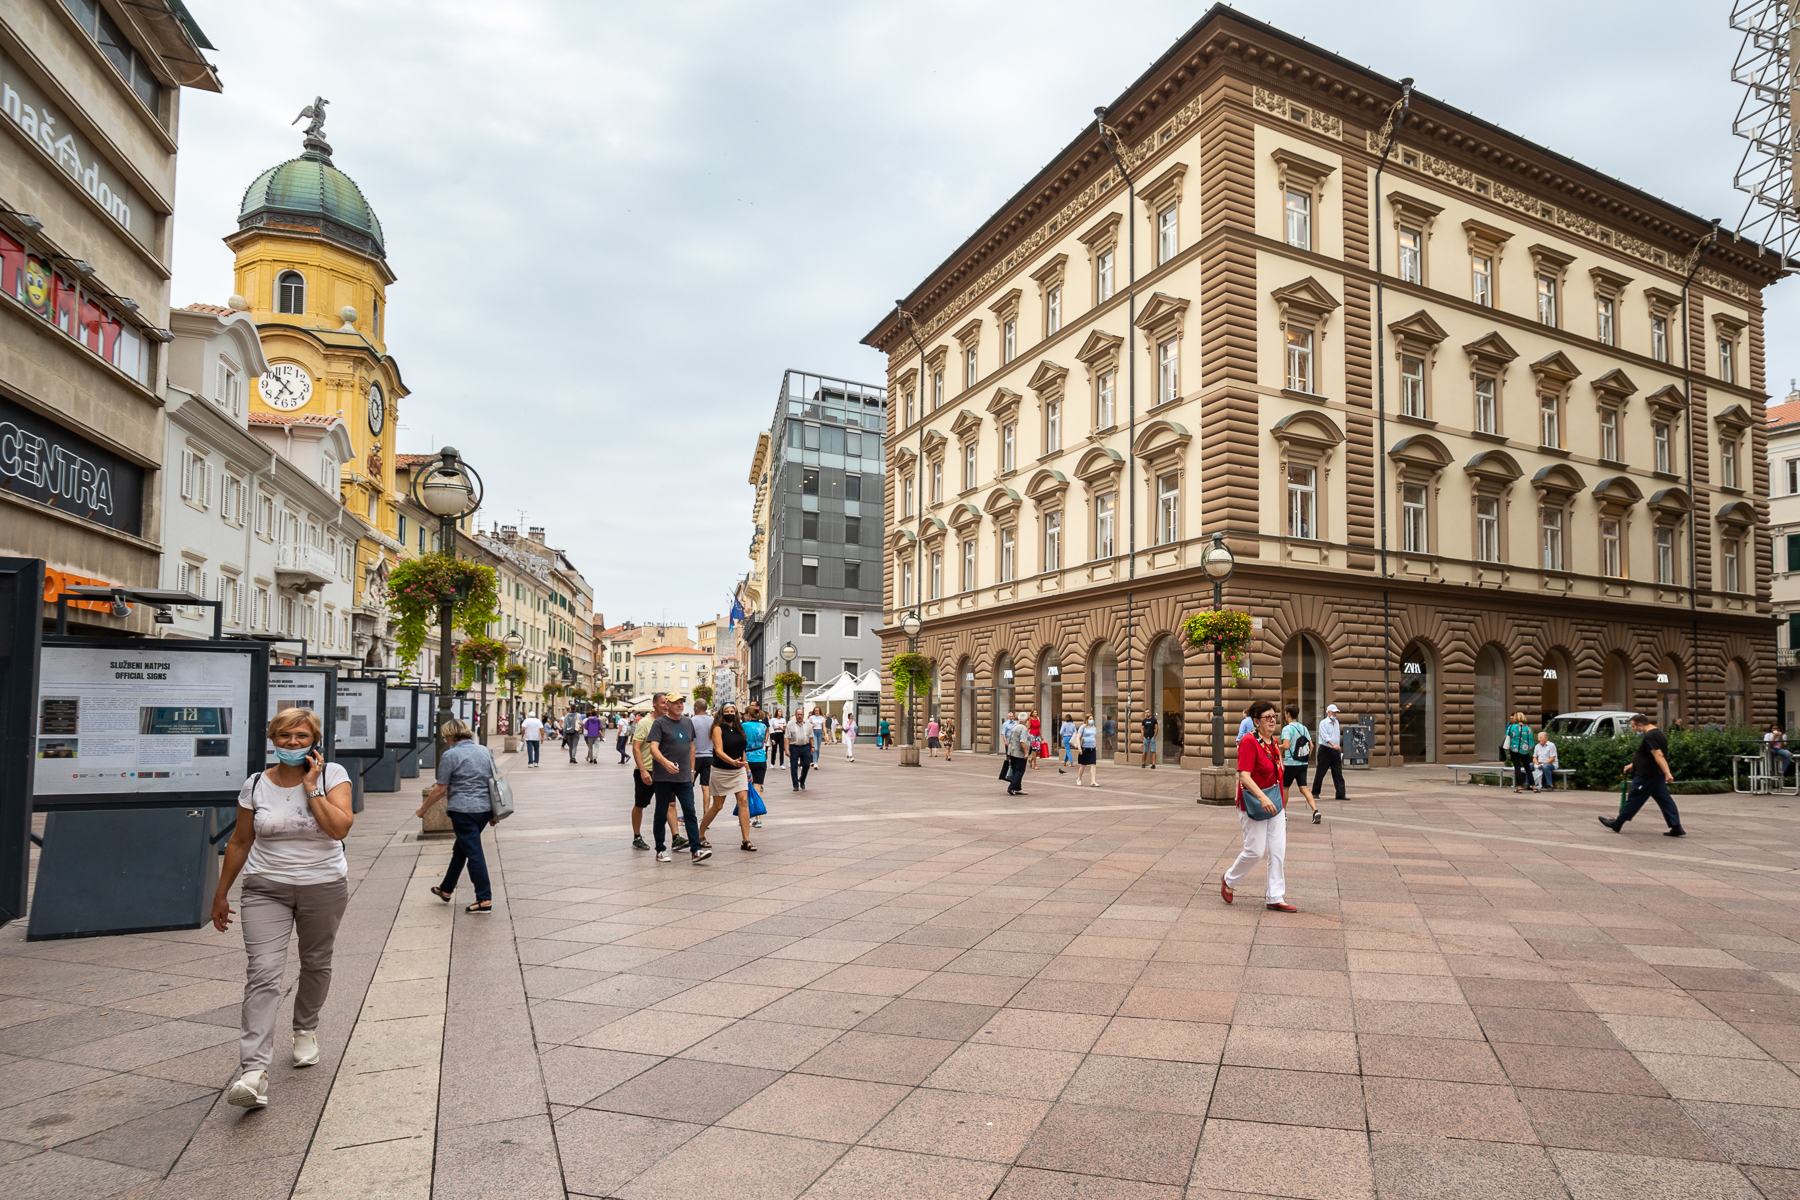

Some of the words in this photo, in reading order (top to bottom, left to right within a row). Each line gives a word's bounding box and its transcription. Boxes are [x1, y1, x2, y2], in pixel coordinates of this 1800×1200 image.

[3, 82, 56, 157] naš
[83, 161, 131, 232] dom
[275, 367, 281, 376] 11
[283, 366, 292, 375] 12
[295, 369, 299, 378] 1
[266, 371, 275, 380] 10
[300, 374, 306, 383] 2
[261, 380, 268, 389] 9
[304, 383, 310, 392] 3
[265, 390, 272, 399] 8
[298, 392, 305, 401] 4
[281, 399, 288, 408] 6
[291, 398, 297, 406] 5
[0, 421, 113, 516] CENTRA
[110, 660, 143, 669] SLUŽBENI
[144, 662, 171, 670] NATPISI
[1404, 662, 1421, 673] ZARA
[115, 672, 145, 680] OFFICIAL
[146, 672, 167, 680] SIGNS
[1237, 667, 1250, 676] ARA
[1543, 669, 1557, 679] ZARA
[1657, 674, 1669, 683] ZARA
